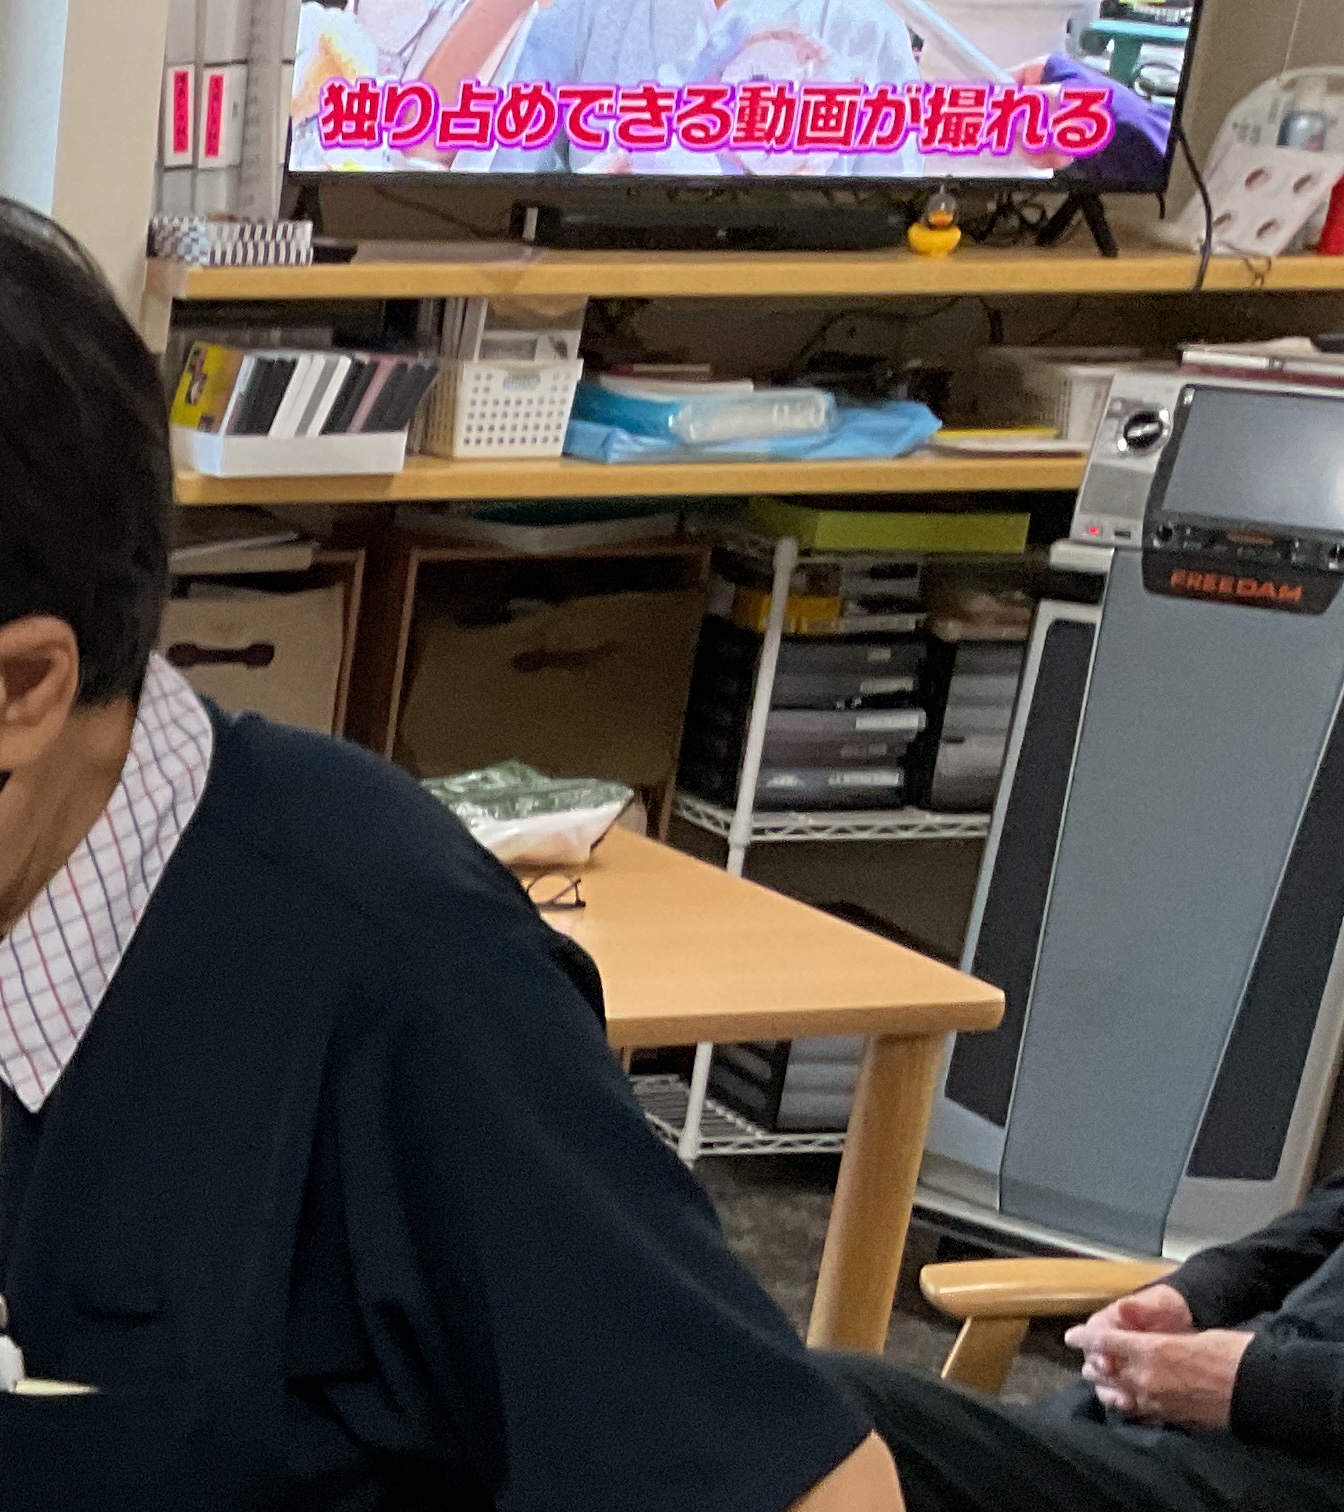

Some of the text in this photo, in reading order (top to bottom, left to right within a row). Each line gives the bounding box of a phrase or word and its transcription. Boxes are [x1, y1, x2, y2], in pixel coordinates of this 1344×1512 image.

[319, 80, 1113, 155] 独り占めできる動画が撮れる
[1170, 568, 1304, 602] FREEDAM
